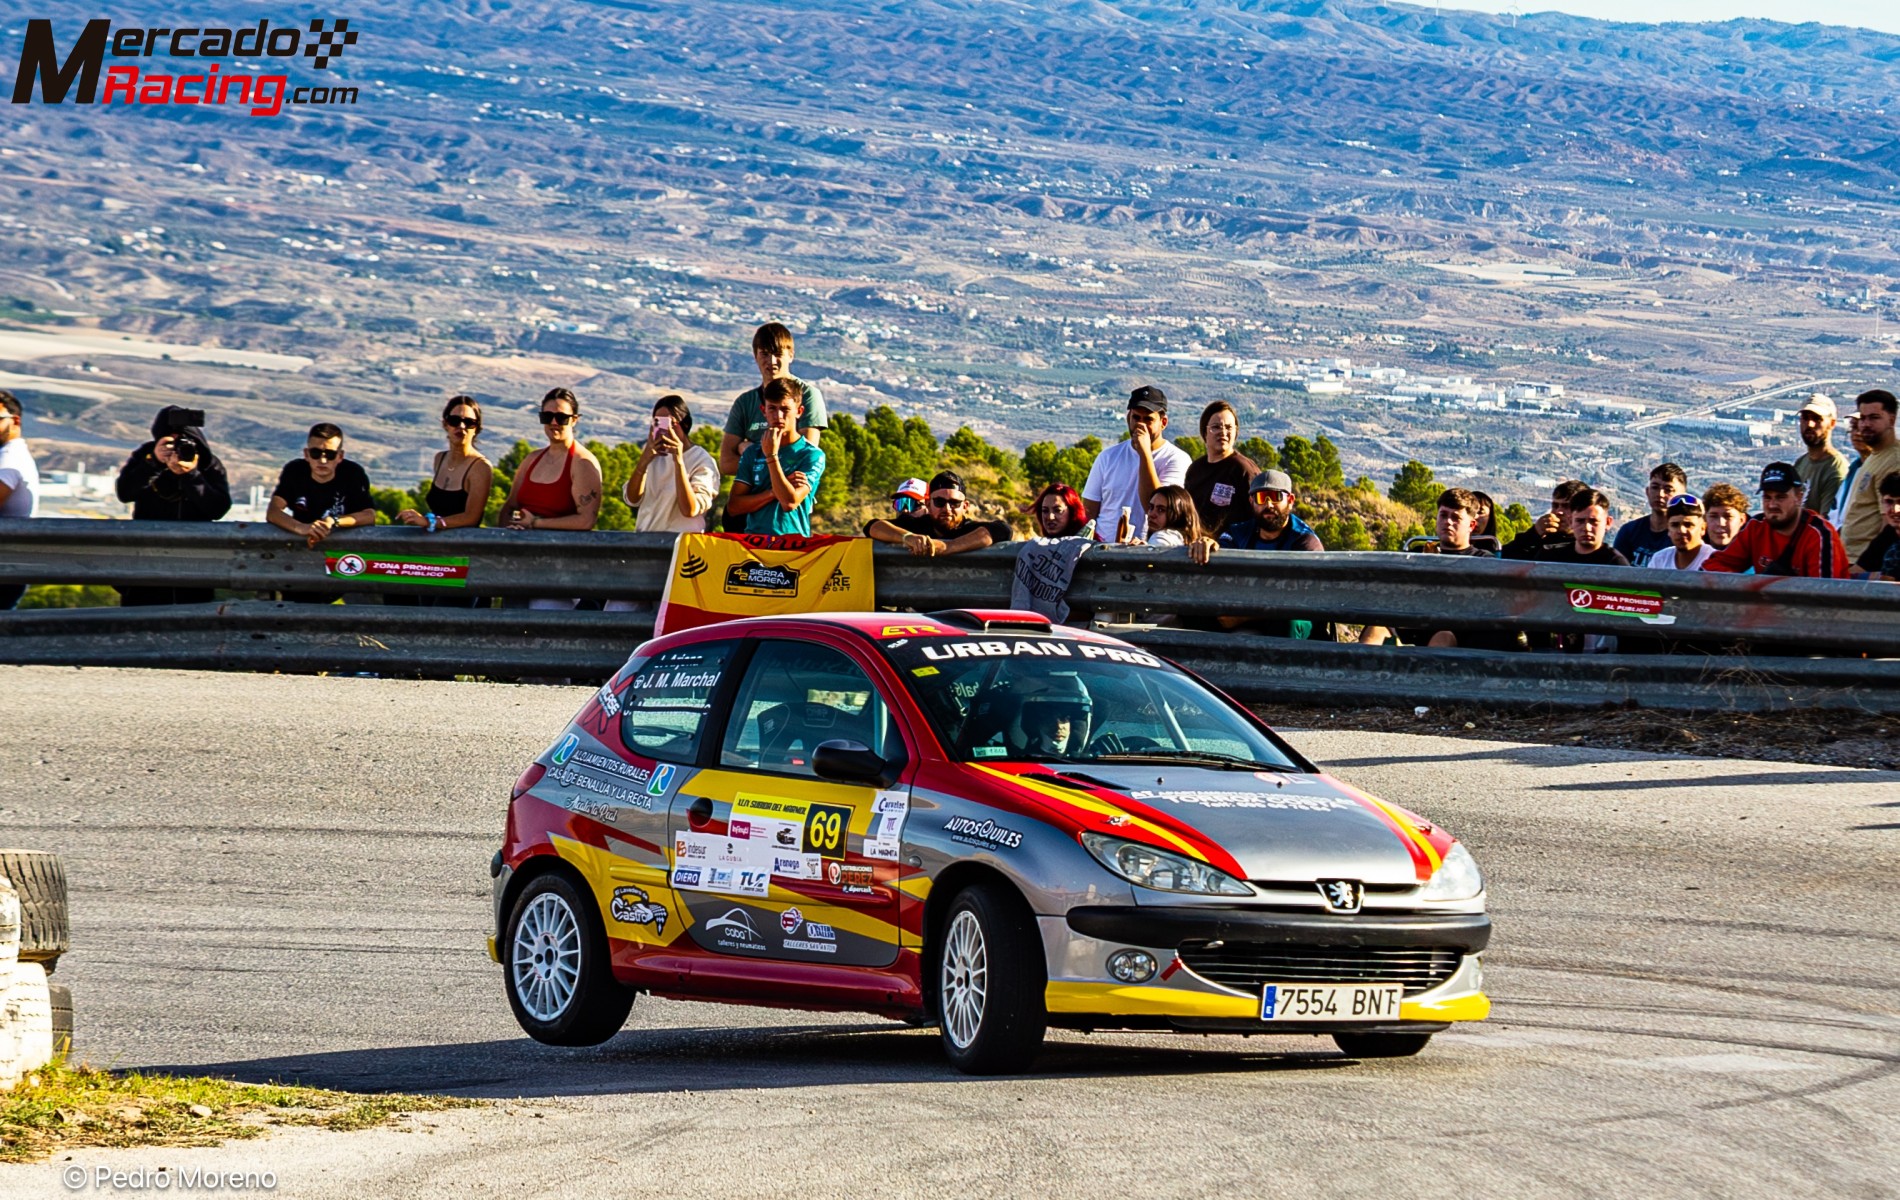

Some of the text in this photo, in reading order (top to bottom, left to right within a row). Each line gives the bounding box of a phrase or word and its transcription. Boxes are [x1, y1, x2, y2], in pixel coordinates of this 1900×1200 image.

[402, 564, 457, 573] PROHIBIDA
[749, 568, 785, 578] SIERRA
[748, 575, 791, 585] MORENA
[1596, 594, 1660, 606] ZONA PROHIBIDA
[921, 641, 1072, 660] URBAN
[1077, 644, 1161, 668] PRO
[642, 671, 722, 689] J. M. Marchal
[572, 749, 651, 782] ALOJAMIENTOS RURALES
[547, 766, 566, 780] CASA
[565, 769, 576, 785] DE
[609, 784, 617, 797] Y
[615, 787, 628, 803] LA
[627, 791, 653, 810] RECTA
[810, 810, 842, 850] 69
[675, 871, 699, 884] DIERO
[784, 939, 809, 950] TALLERES
[1280, 989, 1398, 1015] 7554 BNT
